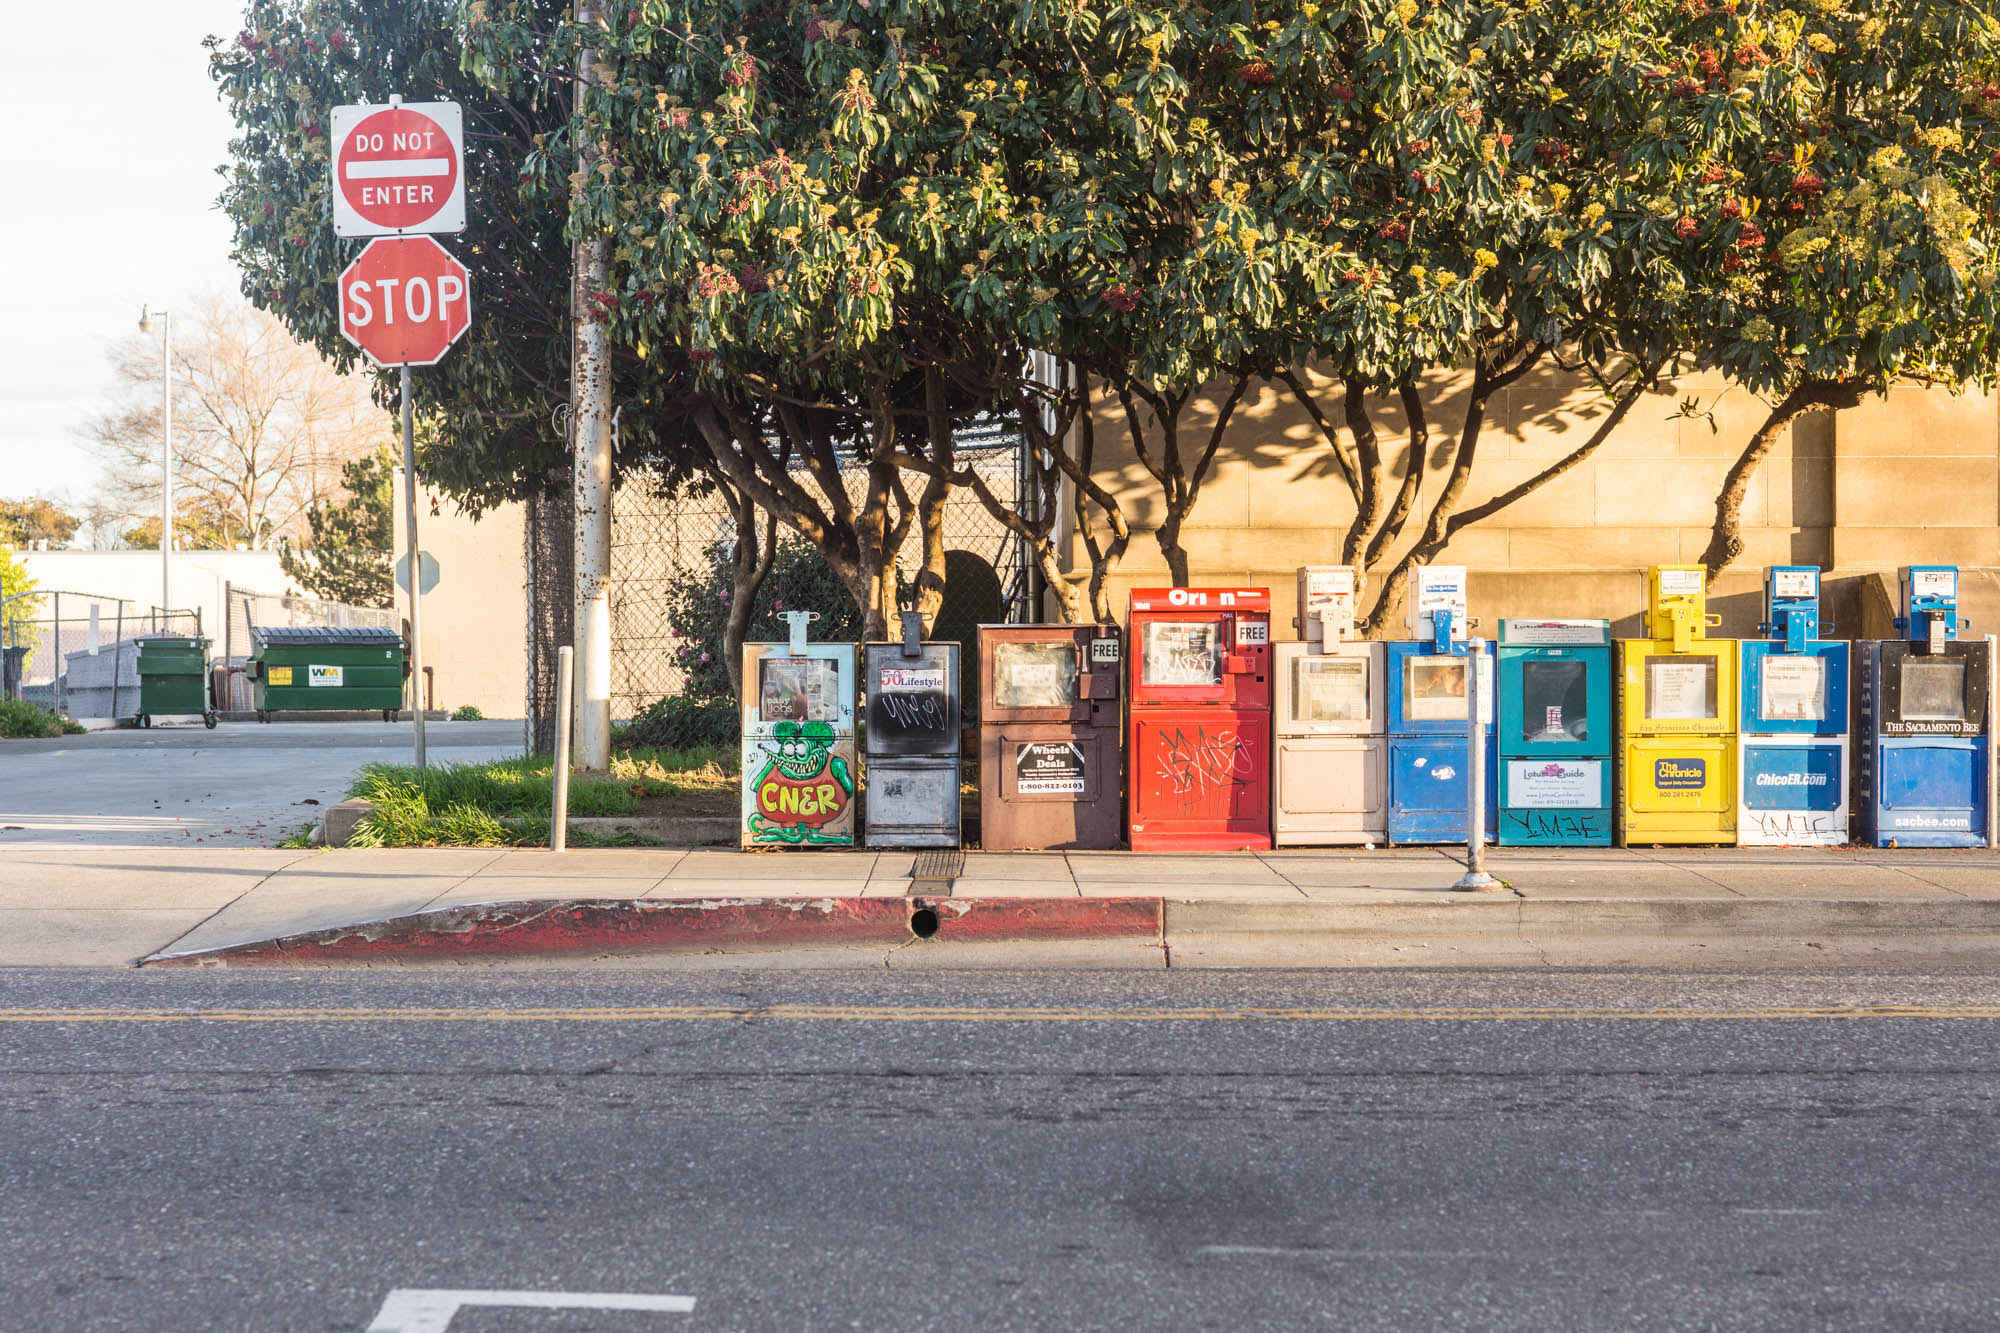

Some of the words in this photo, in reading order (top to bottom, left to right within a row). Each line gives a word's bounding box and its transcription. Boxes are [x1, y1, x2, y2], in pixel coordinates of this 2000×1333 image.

[356, 134, 383, 152] DO
[393, 132, 434, 151] NOT
[362, 185, 433, 206] ENTER
[348, 275, 463, 327] STOP
[1240, 627, 1265, 640] FREE
[1093, 644, 1118, 657] FREE
[312, 669, 338, 677] WM
[901, 677, 943, 688] Lifestyle
[1886, 722, 1904, 732] THE
[1905, 722, 1961, 732] SACRAMENTO
[1963, 722, 1980, 732] BEE
[1032, 745, 1070, 755] Wheels
[1036, 759, 1066, 768] Deals
[1660, 762, 1678, 770] The
[1556, 767, 1585, 779] Guide
[1658, 768, 1702, 778] Chronicle
[1756, 773, 1827, 786] ChicoER.com
[1020, 782, 1083, 790] 1-800-822-0103
[762, 782, 840, 815] CN&R
[1895, 815, 1969, 827] sacbee.com
